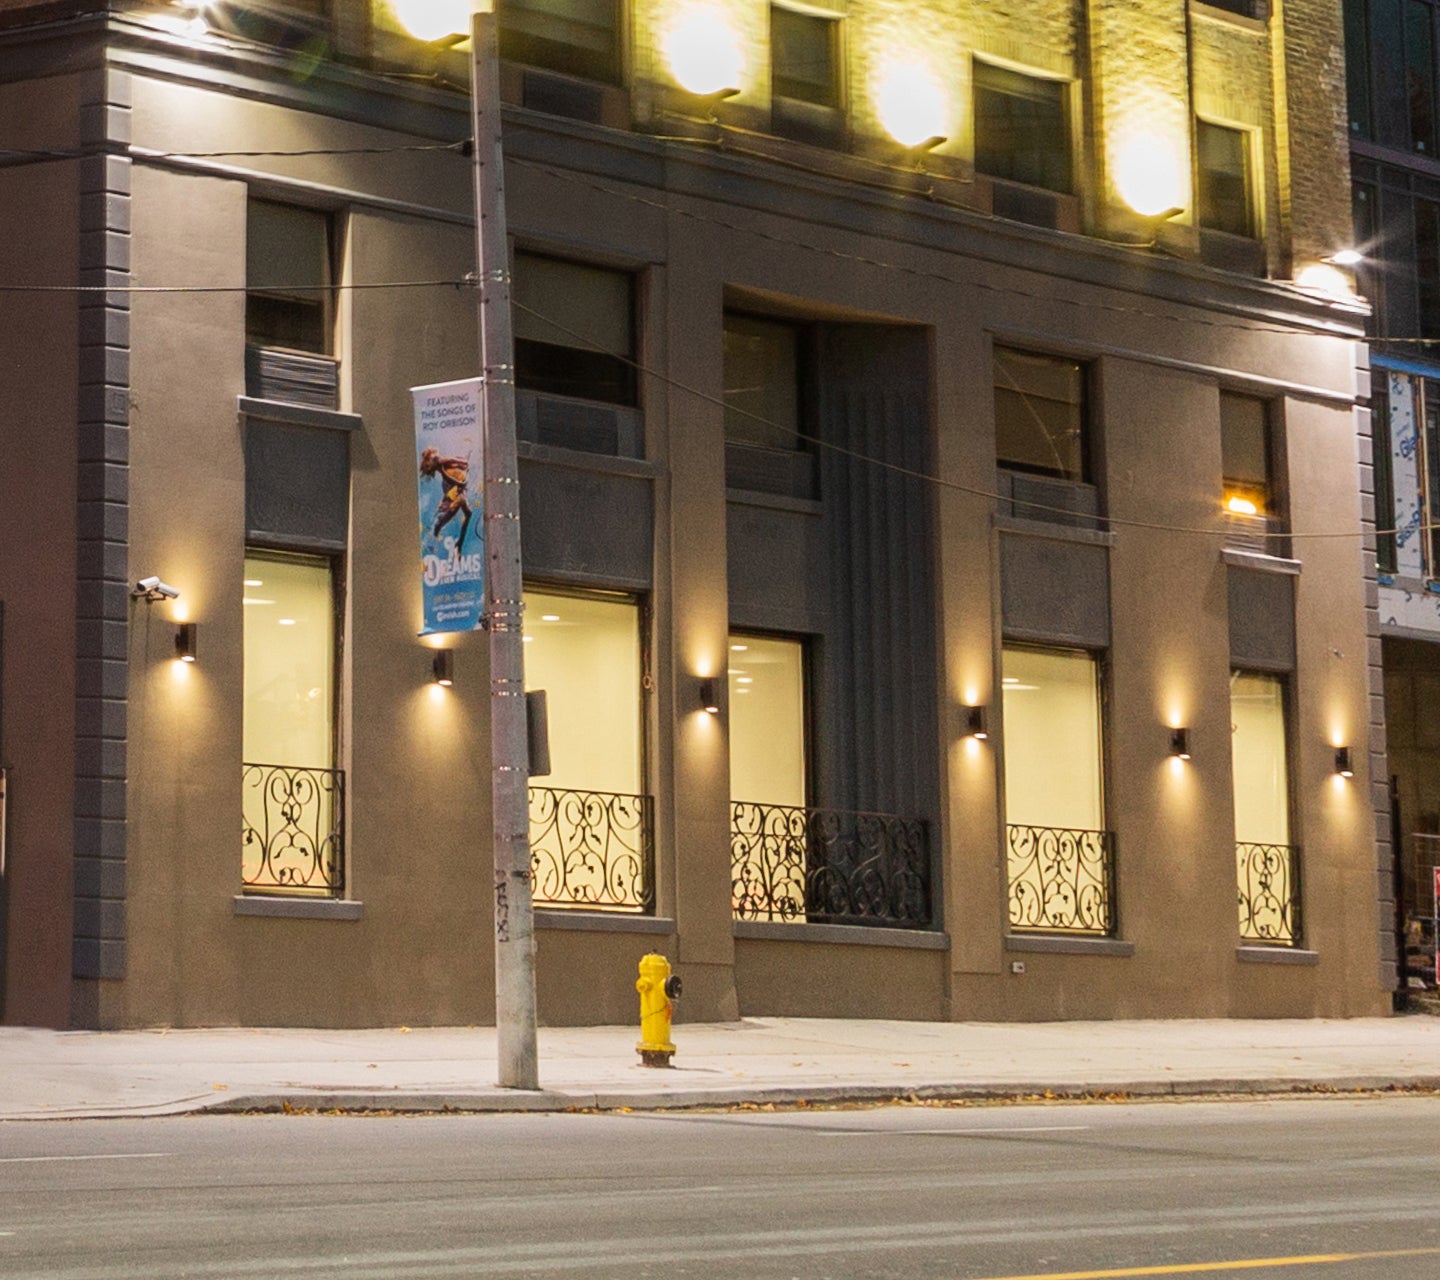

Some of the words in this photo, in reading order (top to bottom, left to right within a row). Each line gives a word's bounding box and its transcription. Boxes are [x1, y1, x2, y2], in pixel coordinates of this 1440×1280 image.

[427, 393, 469, 407] FEATURING
[421, 408, 435, 419] THE
[437, 406, 464, 418] SONGS
[465, 404, 476, 414] OF
[423, 421, 438, 431] ROY
[440, 416, 476, 429] ORBISON
[423, 553, 481, 587] DREAMS
